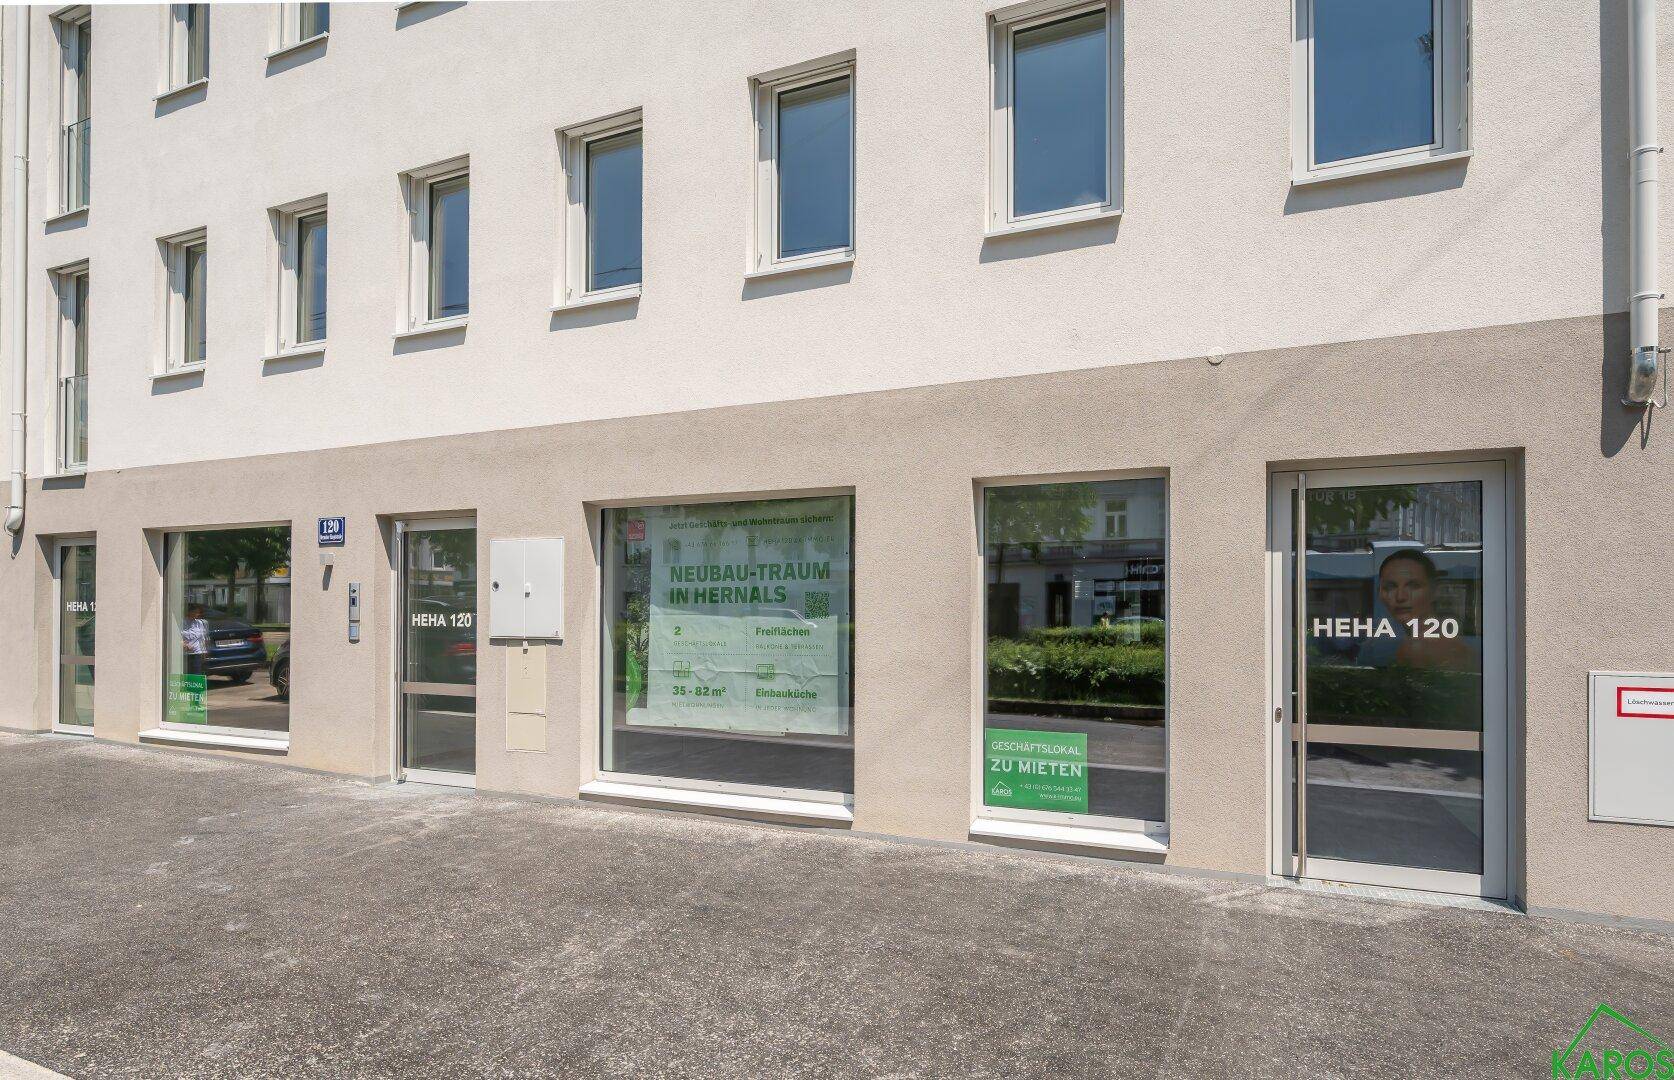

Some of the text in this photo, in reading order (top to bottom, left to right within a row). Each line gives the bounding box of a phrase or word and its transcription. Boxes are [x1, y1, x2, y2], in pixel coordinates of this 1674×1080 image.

[322, 519, 339, 534] 120
[669, 521, 688, 531] Jetzt
[732, 518, 748, 528] und
[750, 516, 799, 527] Wohntraum
[800, 515, 834, 525] sichern:
[670, 561, 830, 583] NEUBAU-TRAUM
[669, 585, 787, 604] IN HERNALS
[66, 601, 97, 612] HEHA 1
[412, 613, 472, 628] HEHA 120
[674, 626, 682, 636] 2
[755, 627, 811, 637] Freiflächen
[1313, 617, 1459, 639] HEHA 120
[169, 692, 204, 702] ZU MIETEN
[672, 685, 686, 696] 35
[694, 686, 710, 697] 82
[711, 686, 727, 697] m²
[755, 688, 818, 700] Einbauküche
[991, 741, 1080, 755] GESCHÄFTSLOKAL
[990, 758, 1082, 778] ZU MIETEN
